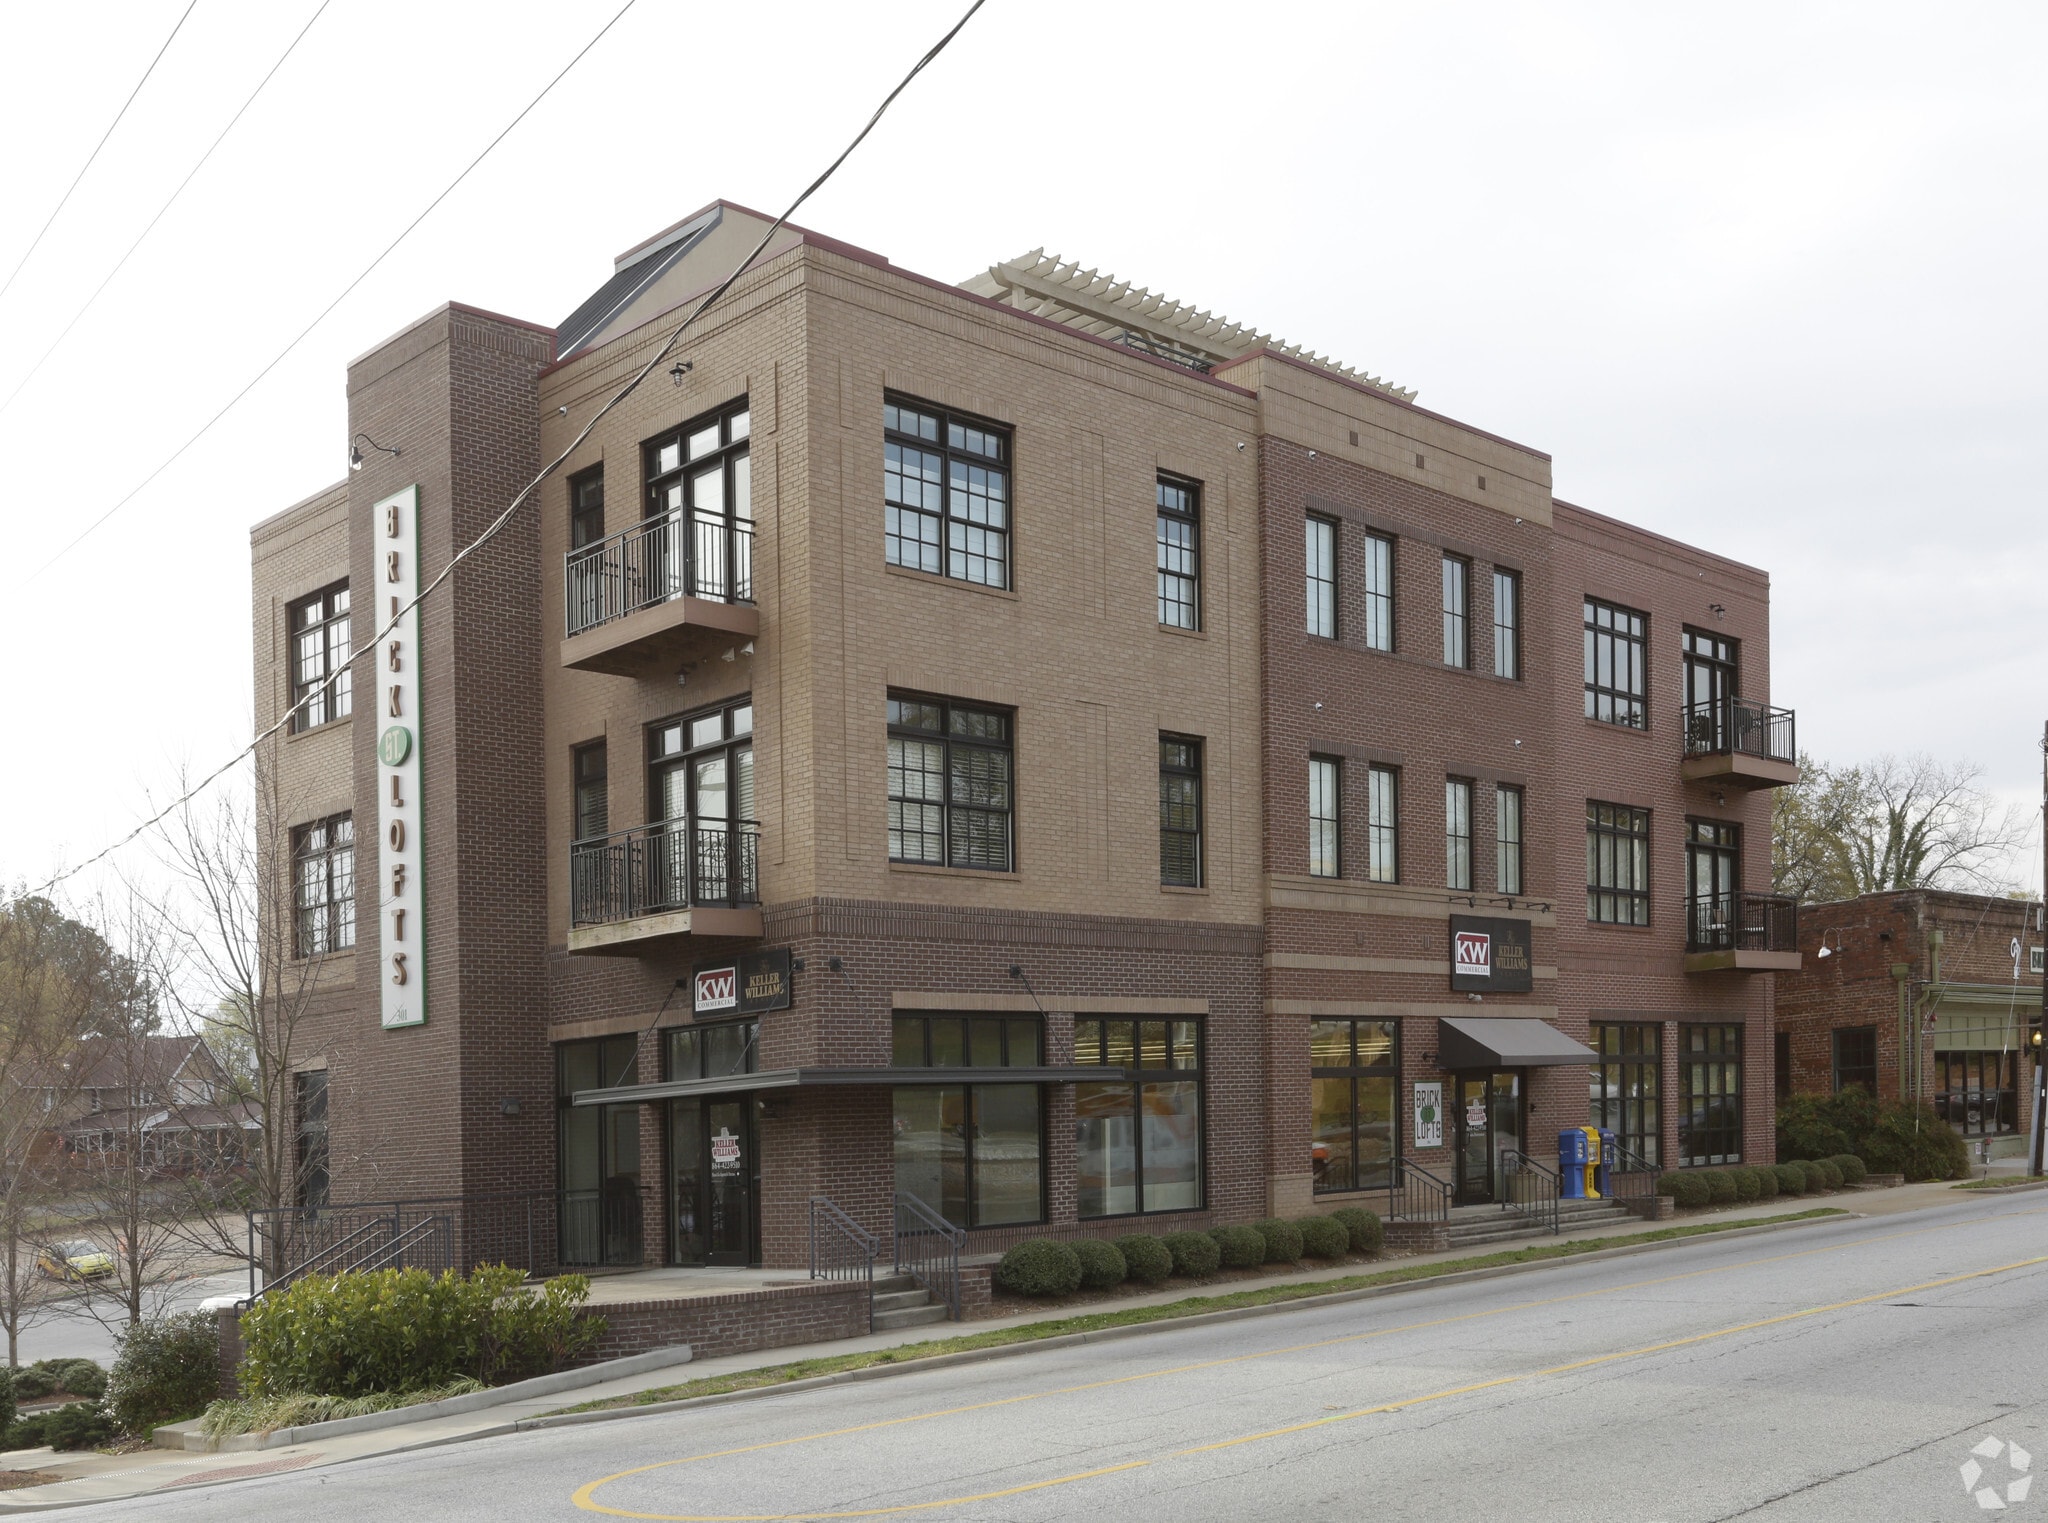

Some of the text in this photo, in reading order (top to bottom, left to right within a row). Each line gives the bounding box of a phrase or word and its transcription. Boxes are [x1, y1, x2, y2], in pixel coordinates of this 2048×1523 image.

[386, 505, 402, 719] BRICK
[390, 774, 408, 987] LOFTS
[1457, 940, 1488, 964] KW
[1498, 945, 1524, 957] KELLER
[1456, 964, 1489, 974] COMMERCIAL
[1495, 957, 1528, 970] WILLIAMS
[749, 972, 780, 987] KELLER
[698, 976, 733, 1001] KW
[745, 983, 785, 999] WILLIAMS
[697, 999, 734, 1009] COMMERCIAL
[1416, 1089, 1440, 1109] BRICK
[1416, 1120, 1441, 1139] LOFTS
[715, 1139, 735, 1148] KELLER
[713, 1147, 739, 1157] WILLIAMS
